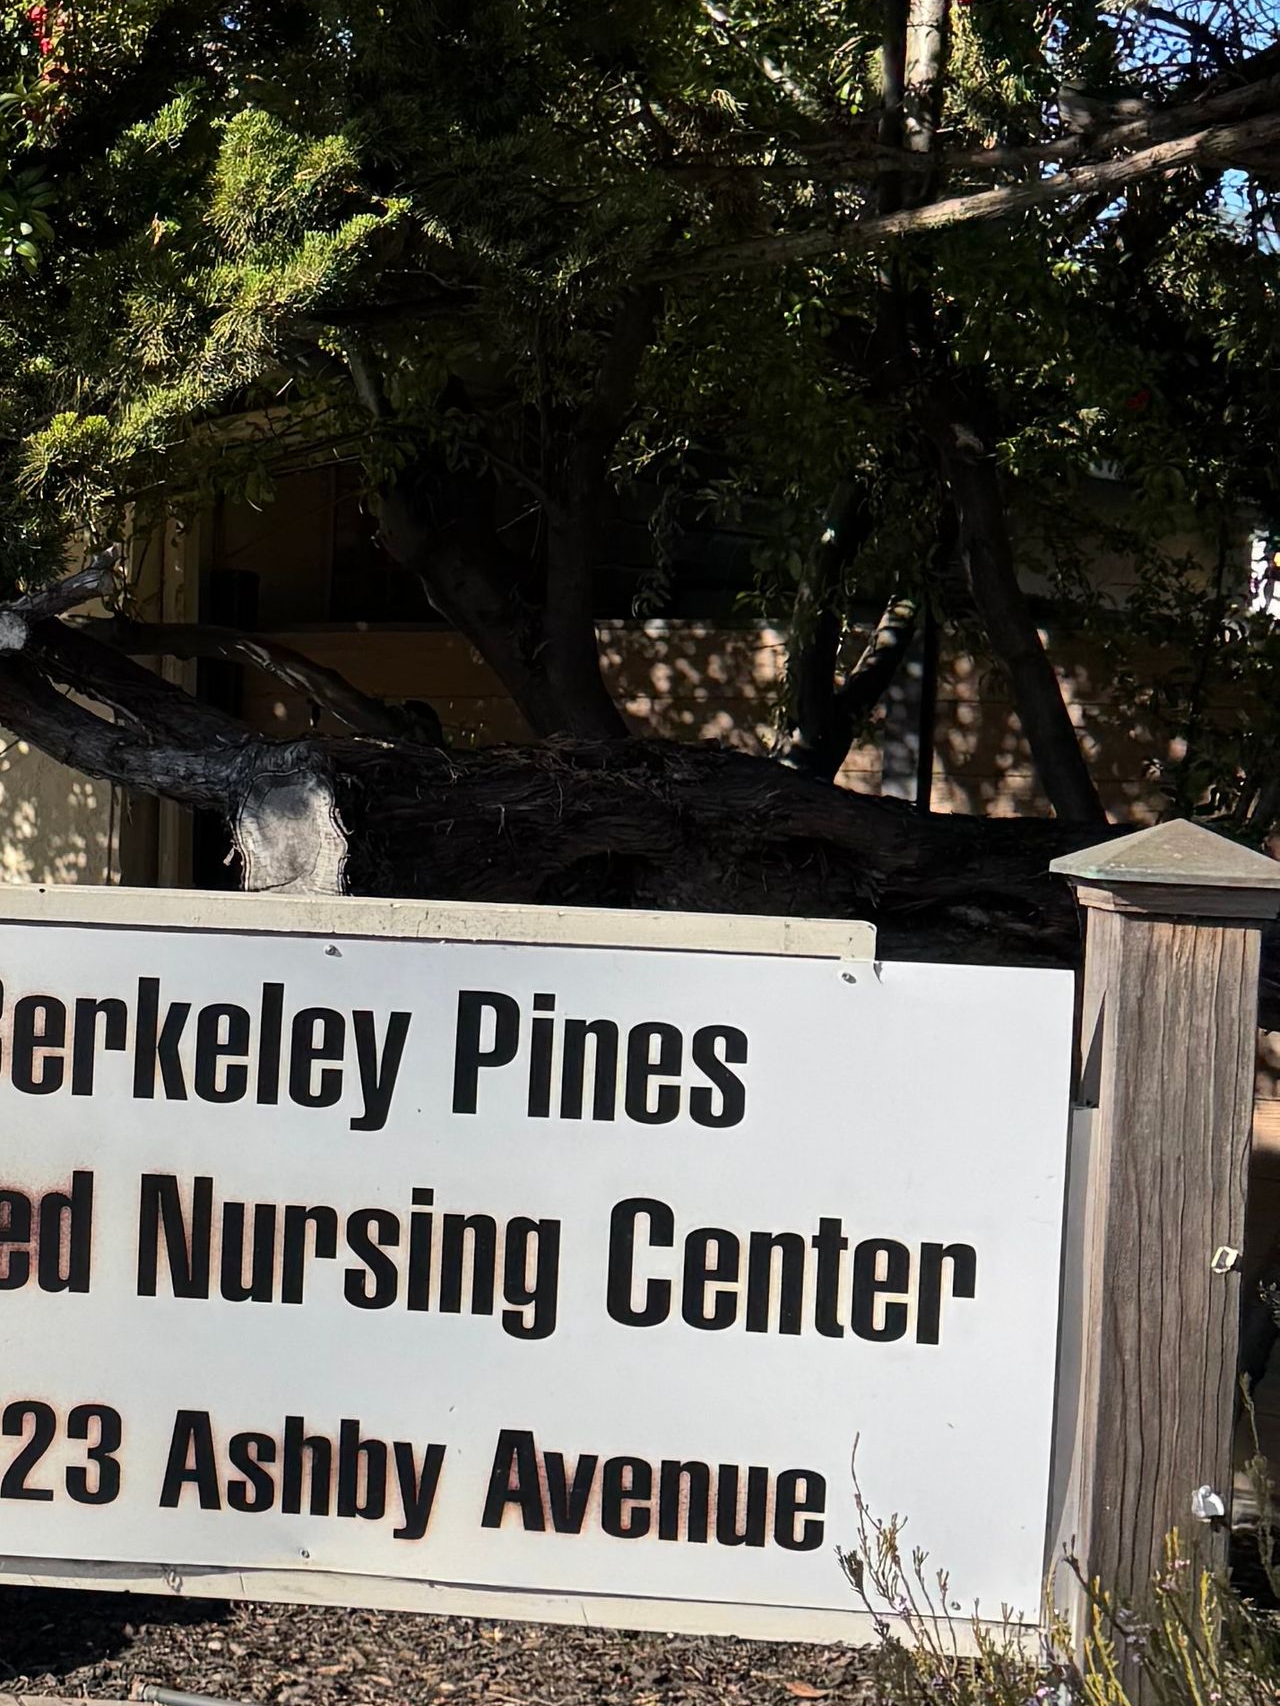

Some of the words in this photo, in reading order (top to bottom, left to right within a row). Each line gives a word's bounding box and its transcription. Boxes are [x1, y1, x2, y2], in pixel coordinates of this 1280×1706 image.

[453, 990, 747, 1128] Pines
[137, 1174, 560, 1340] Nursing
[607, 1198, 976, 1345] Center
[159, 1409, 446, 1540] Ashby
[481, 1429, 826, 1552] Avenue
